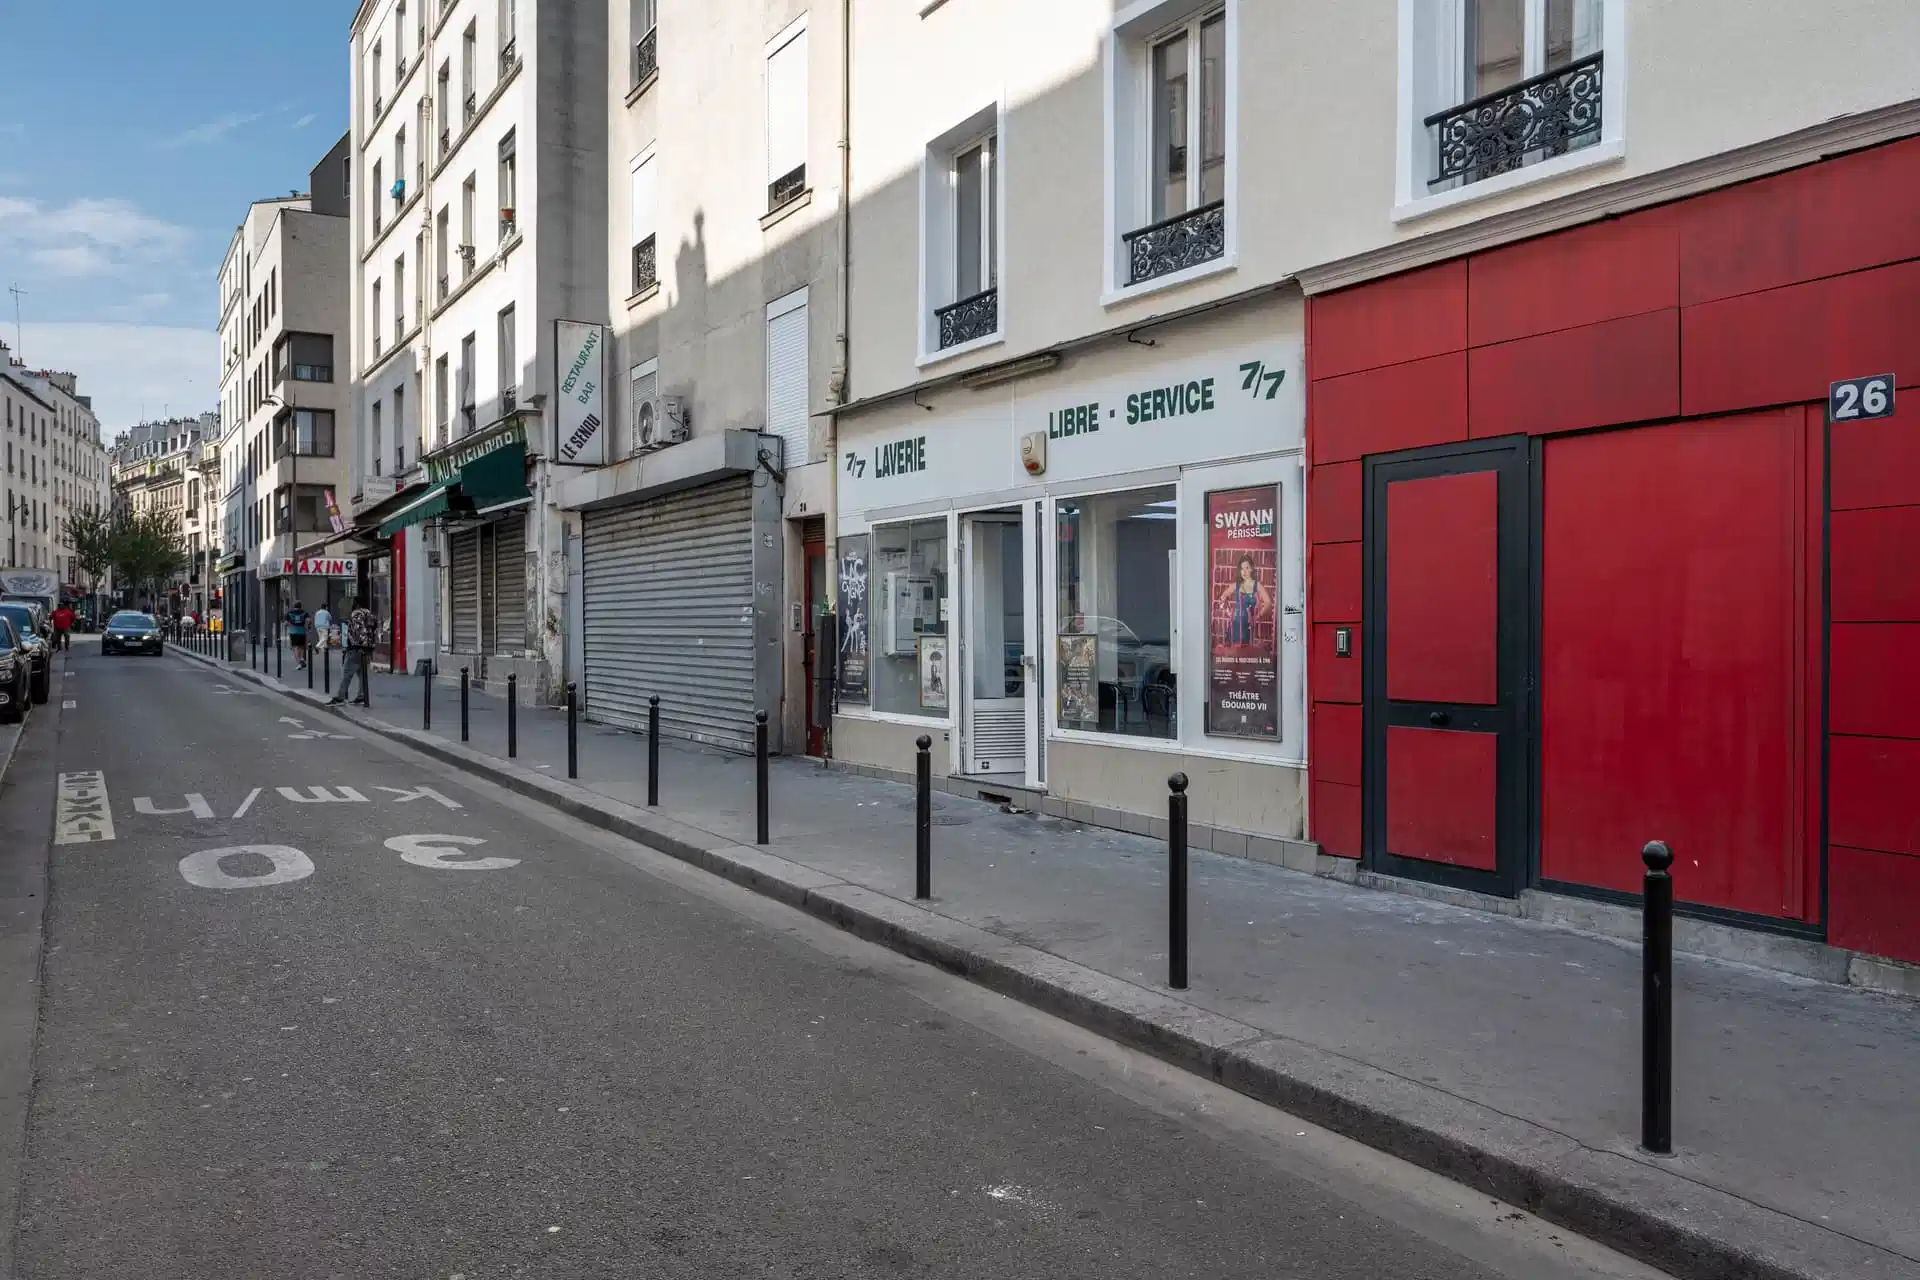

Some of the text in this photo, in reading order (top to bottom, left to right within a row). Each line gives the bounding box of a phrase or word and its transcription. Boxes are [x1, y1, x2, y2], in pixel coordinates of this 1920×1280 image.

[561, 330, 600, 394] RESTAURANT
[578, 381, 596, 404] BAR
[1836, 380, 1887, 418] 26
[845, 452, 866, 478] 7/7
[875, 436, 926, 479] LAVERIE
[1050, 402, 1099, 440] LIBRE
[1126, 378, 1215, 425] SERVICE
[1240, 360, 1286, 400] 7/7
[560, 443, 578, 460] LE
[1215, 508, 1274, 529] SWANN
[1228, 690, 1261, 700] THÉÂTRE
[178, 833, 522, 889] 30
